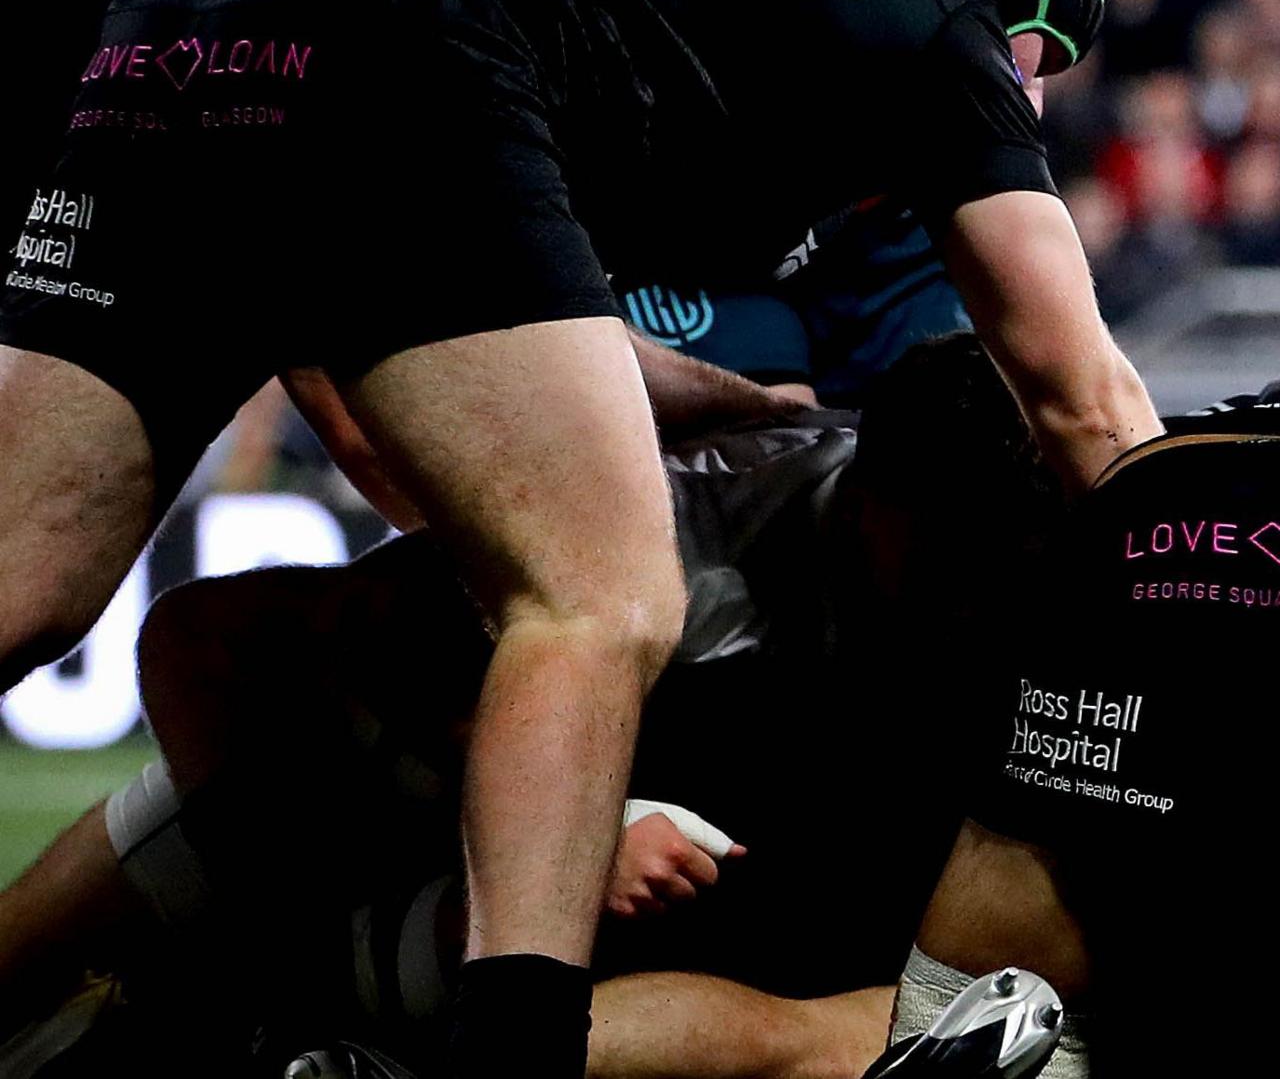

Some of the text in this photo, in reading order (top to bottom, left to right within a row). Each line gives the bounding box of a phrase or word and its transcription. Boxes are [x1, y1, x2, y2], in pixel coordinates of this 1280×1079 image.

[81, 39, 312, 82] LOVE LOAN
[43, 189, 94, 230] Hall
[68, 281, 115, 308] Group
[1126, 520, 1239, 560] LOVE
[1132, 582, 1222, 601] GEORGE
[1019, 678, 1143, 732] Ross Hall
[1010, 717, 1122, 772] Hospital
[1034, 770, 1072, 793] Circle
[1074, 777, 1121, 803] Health
[1123, 788, 1174, 814] Group
